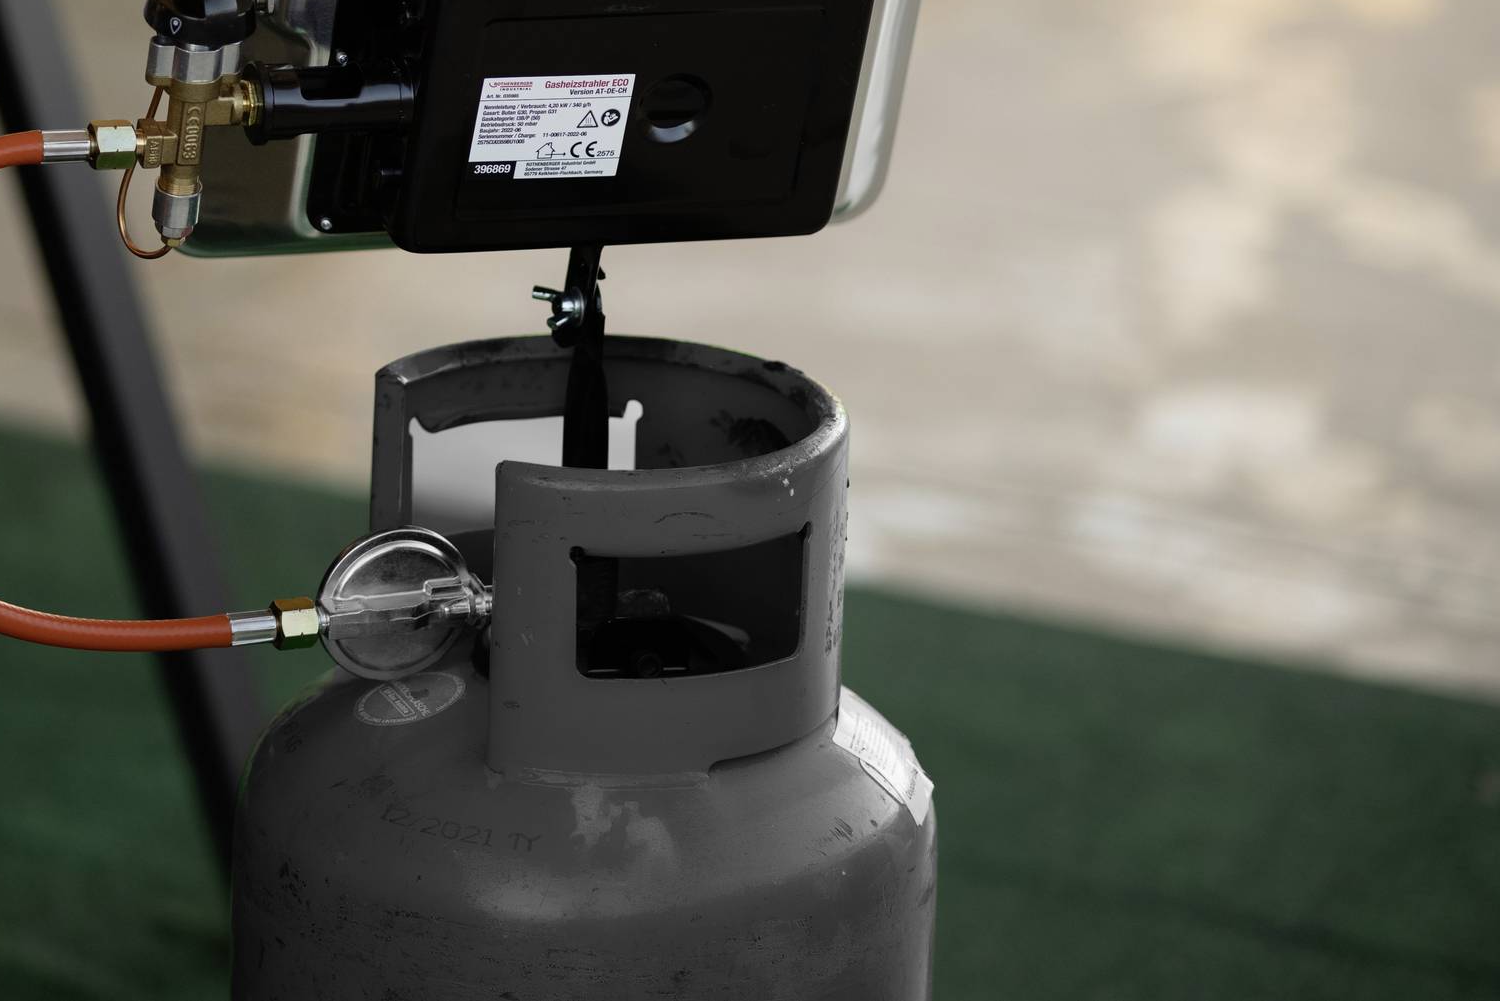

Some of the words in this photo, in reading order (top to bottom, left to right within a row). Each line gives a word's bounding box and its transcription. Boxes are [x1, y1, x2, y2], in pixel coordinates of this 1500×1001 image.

[545, 79, 610, 89] Gasheizstrahler
[612, 79, 629, 87] ECO
[474, 164, 511, 174] 396869
